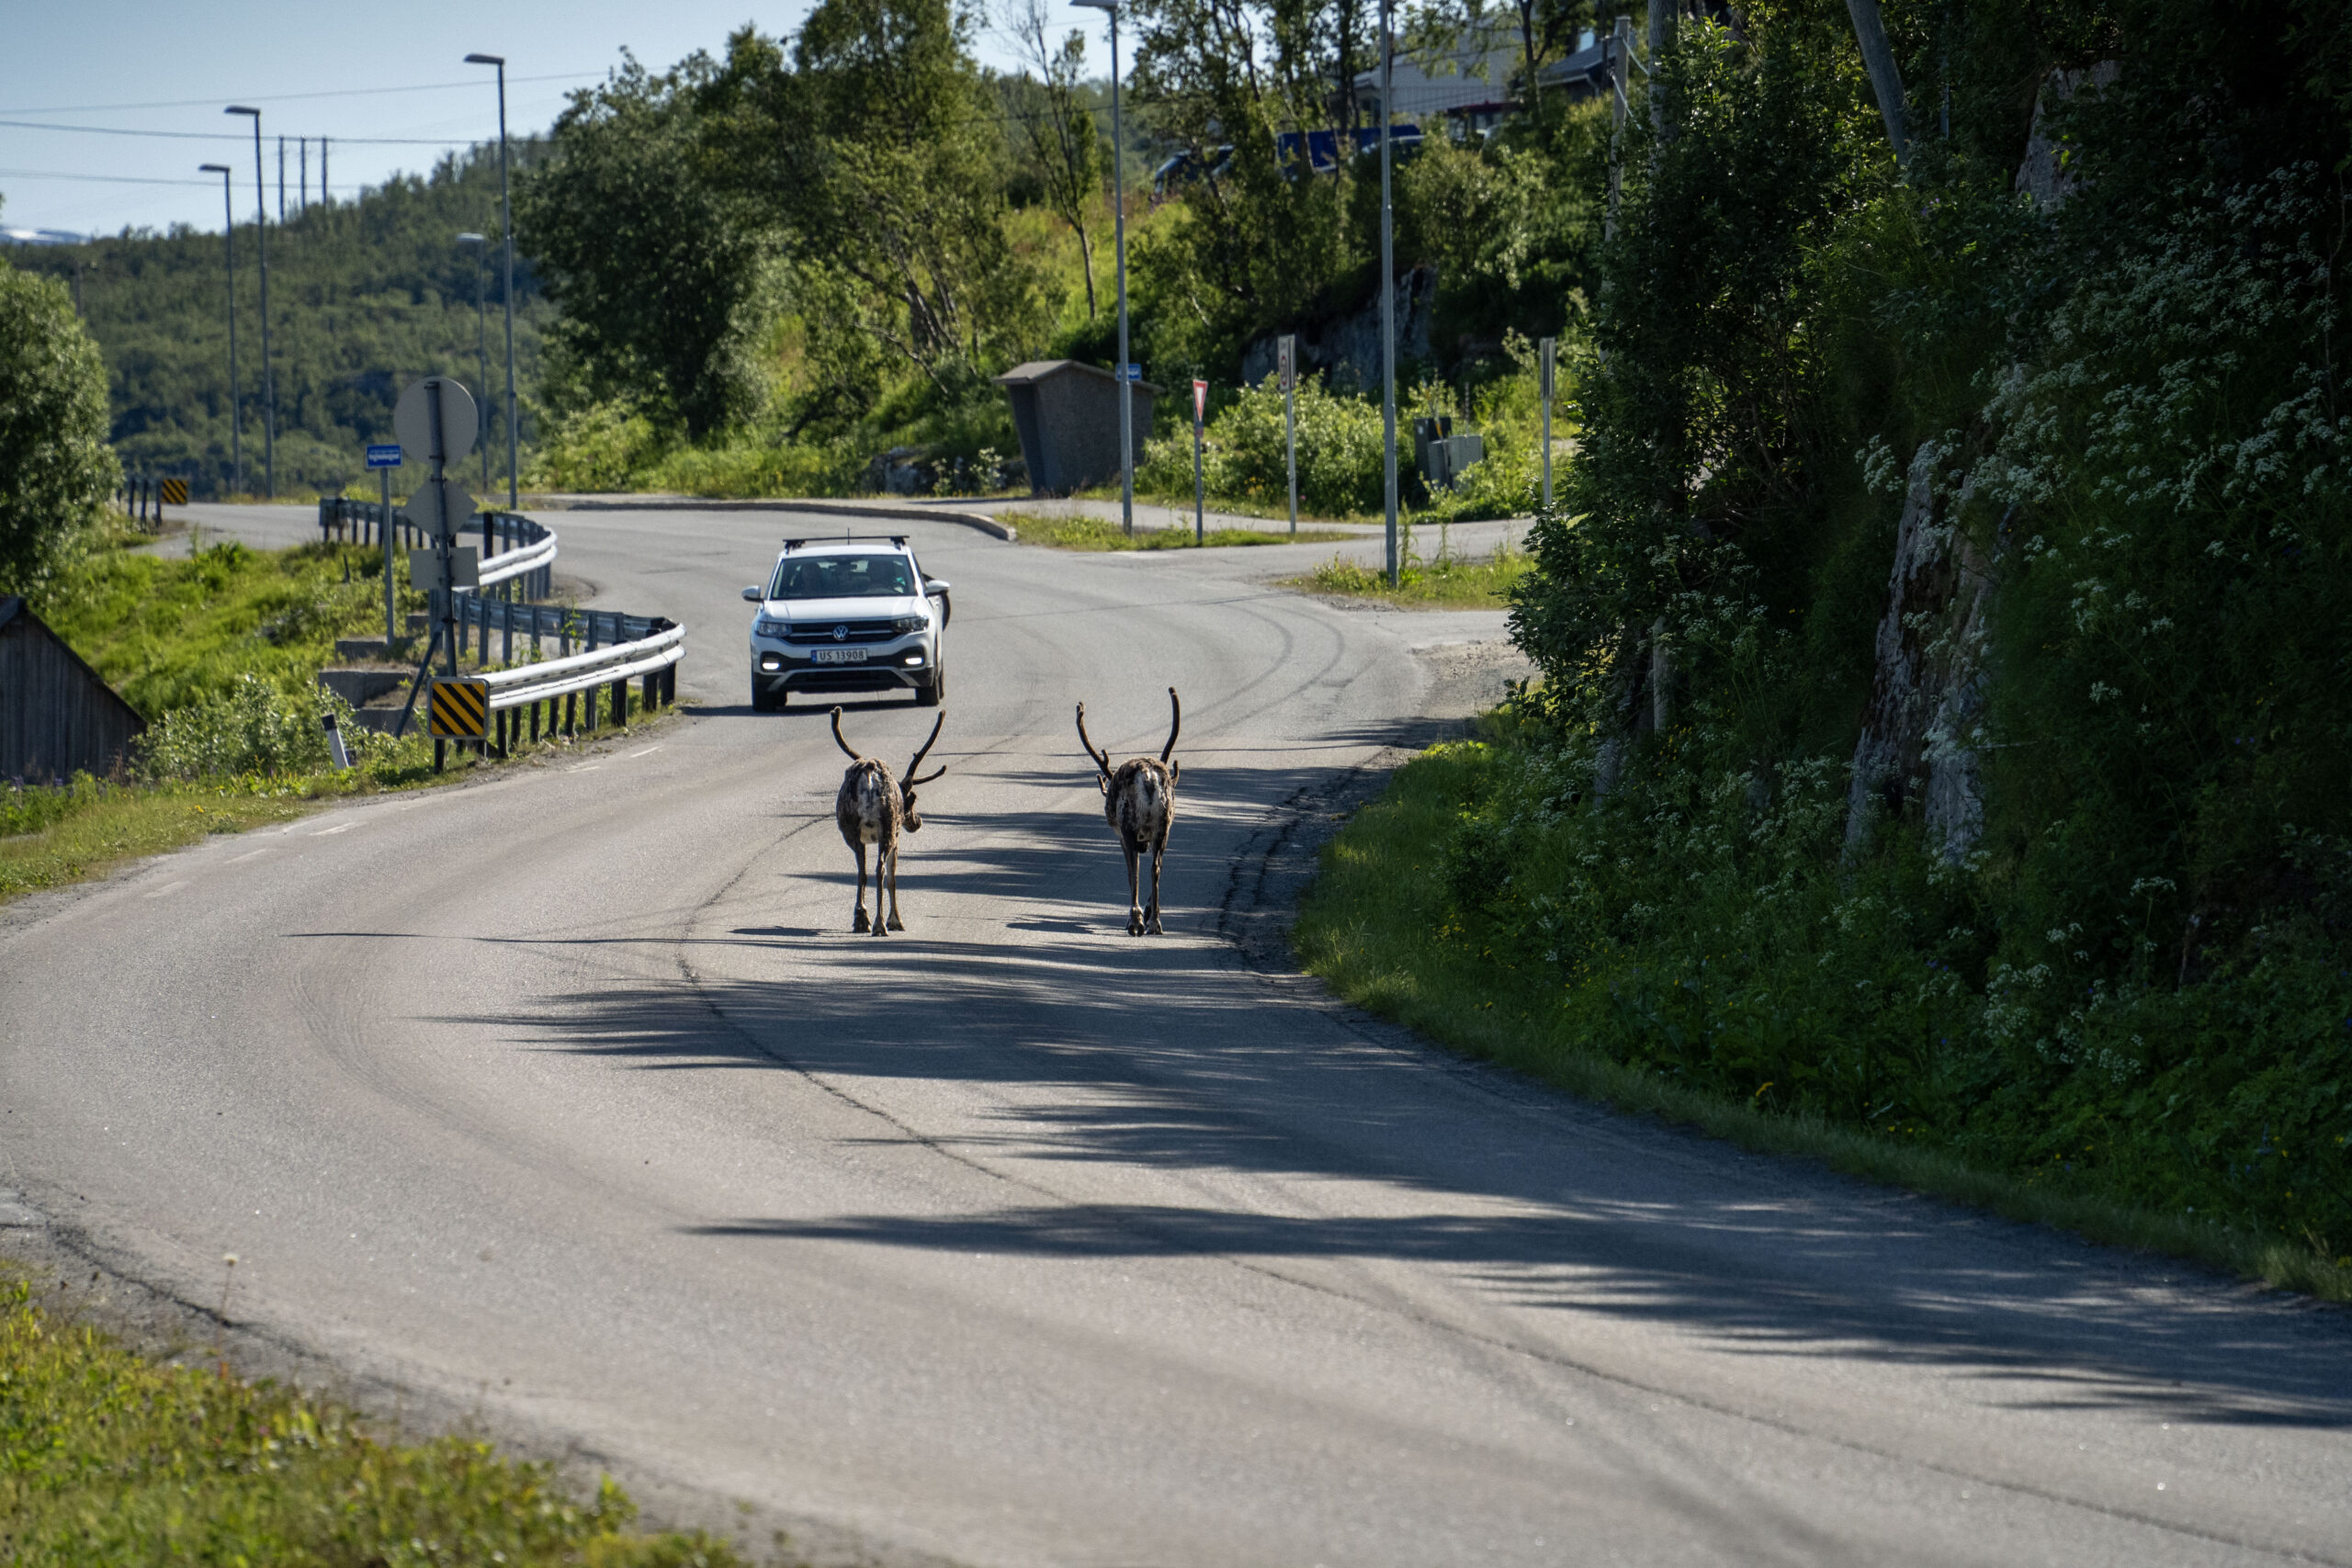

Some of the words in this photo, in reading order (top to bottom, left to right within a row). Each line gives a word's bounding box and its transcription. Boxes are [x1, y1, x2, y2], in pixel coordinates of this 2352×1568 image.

[833, 626, 848, 640] VW
[820, 652, 832, 660] US
[836, 651, 864, 660] 13908
